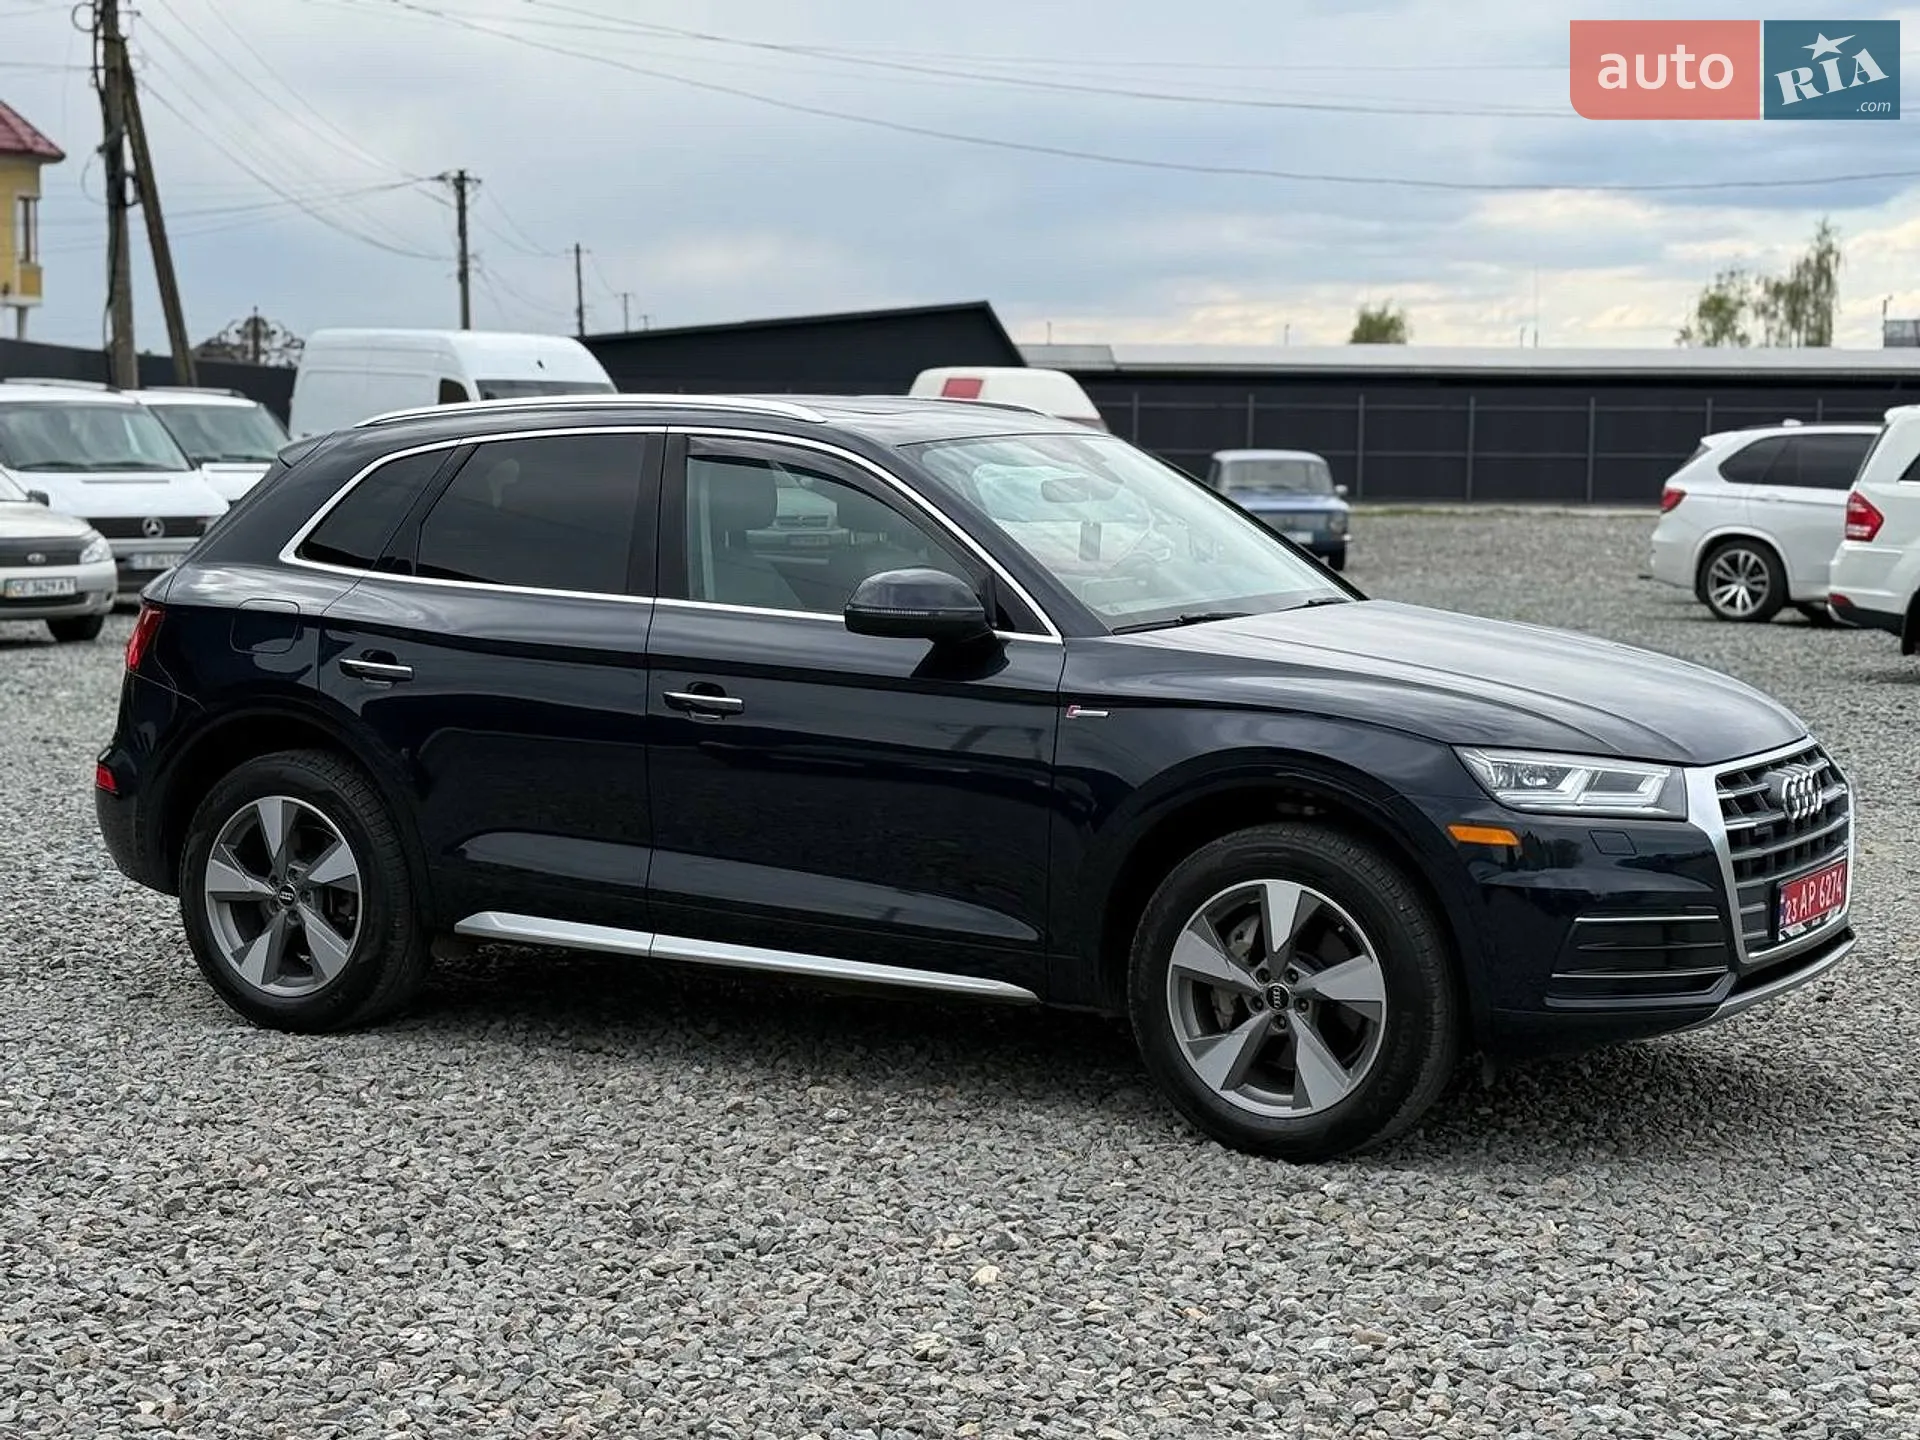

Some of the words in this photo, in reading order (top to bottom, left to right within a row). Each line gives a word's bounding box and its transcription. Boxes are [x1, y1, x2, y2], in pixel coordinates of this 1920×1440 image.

[1785, 898, 1797, 924] 23
[1800, 881, 1816, 917] AP
[1819, 867, 1843, 908] 6274
